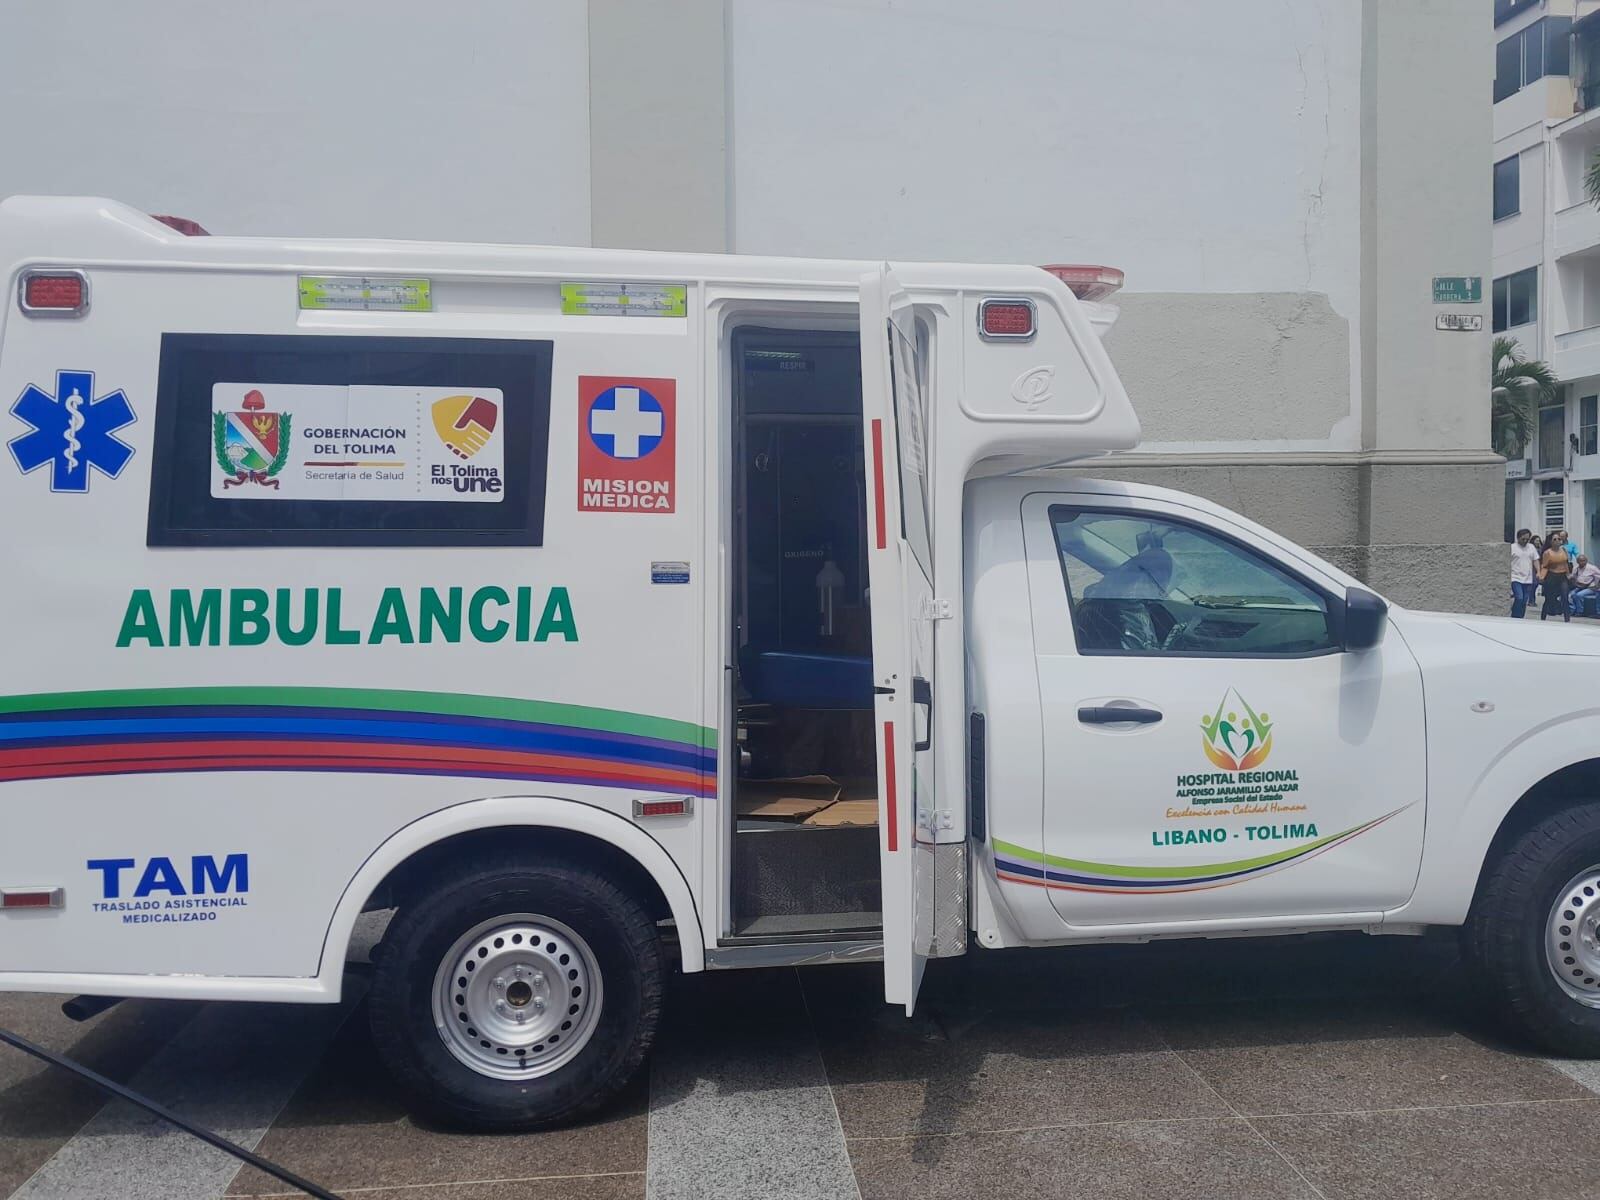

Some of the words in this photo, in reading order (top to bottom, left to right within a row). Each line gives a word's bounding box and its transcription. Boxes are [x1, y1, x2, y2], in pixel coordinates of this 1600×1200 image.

[303, 425, 406, 439] GOBERNACIÓN
[314, 443, 339, 455] DEL
[343, 443, 396, 455] TOLIMA
[305, 470, 356, 481] Secretaría
[359, 470, 373, 480] de
[375, 470, 404, 481] Salud
[431, 464, 445, 477] El
[450, 465, 498, 477] Tolima
[431, 476, 452, 485] nos
[453, 476, 502, 493] une
[583, 478, 669, 494] MISION
[583, 493, 670, 509] MEDICA
[115, 586, 580, 647] AMBULANCIA
[1177, 773, 1235, 786] HOSPITAL
[1238, 770, 1299, 783] REGIONAL
[1176, 787, 1215, 797] ALFONSO
[1216, 785, 1262, 795] JARAMILLO
[1263, 783, 1299, 792] SALAZAR
[1192, 797, 1223, 806] Empresa
[1224, 795, 1245, 803] Social
[1259, 793, 1283, 801] Estado
[1166, 807, 1212, 818] Excelencia
[1232, 804, 1267, 815] Calidad
[1270, 801, 1307, 811] Humana
[1152, 828, 1227, 846] LIBANO
[1245, 824, 1319, 841] TOLIMA
[87, 854, 249, 899] TAM
[93, 901, 160, 912] TRASLADO
[165, 897, 248, 909] ASISTENCIAL
[122, 911, 217, 924] MEDICALIZADO
